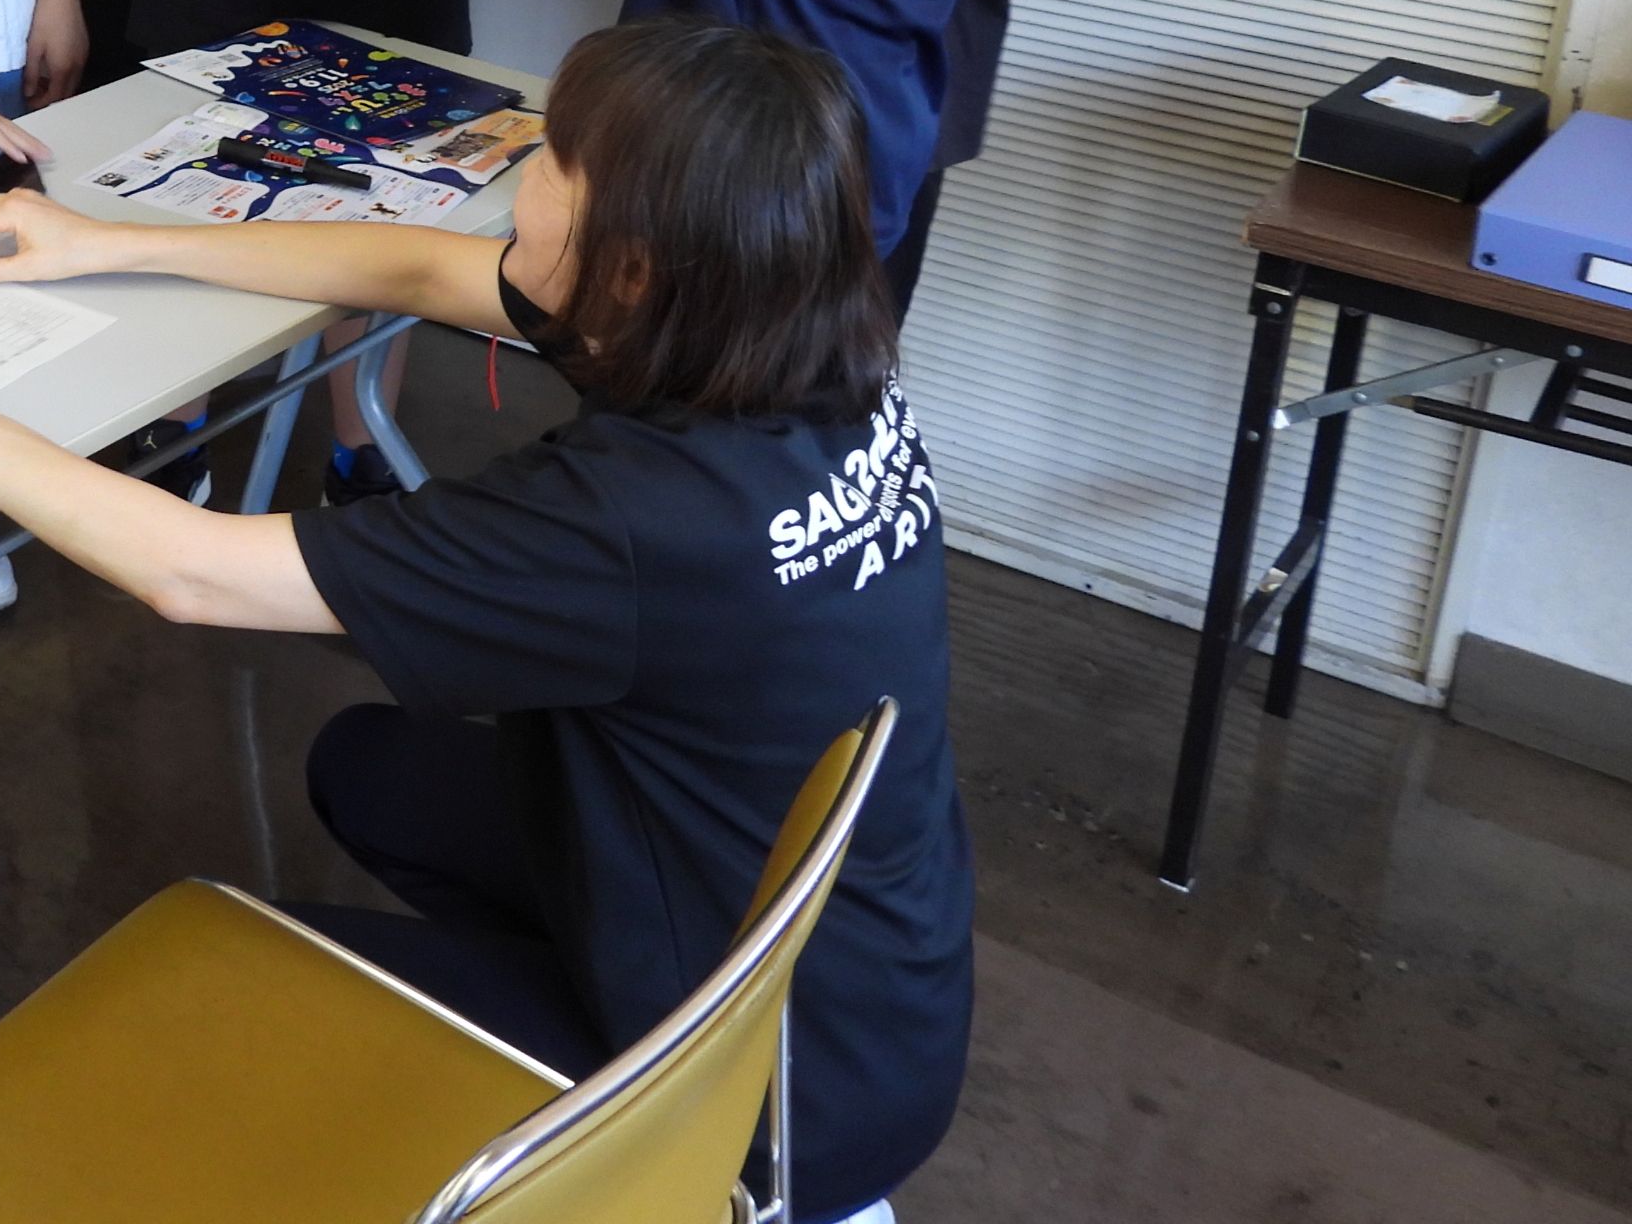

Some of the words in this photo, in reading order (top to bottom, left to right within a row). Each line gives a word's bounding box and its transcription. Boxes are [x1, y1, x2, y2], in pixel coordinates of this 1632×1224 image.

[773, 557, 819, 586] The
[822, 517, 883, 568] power
[891, 438, 912, 473] for
